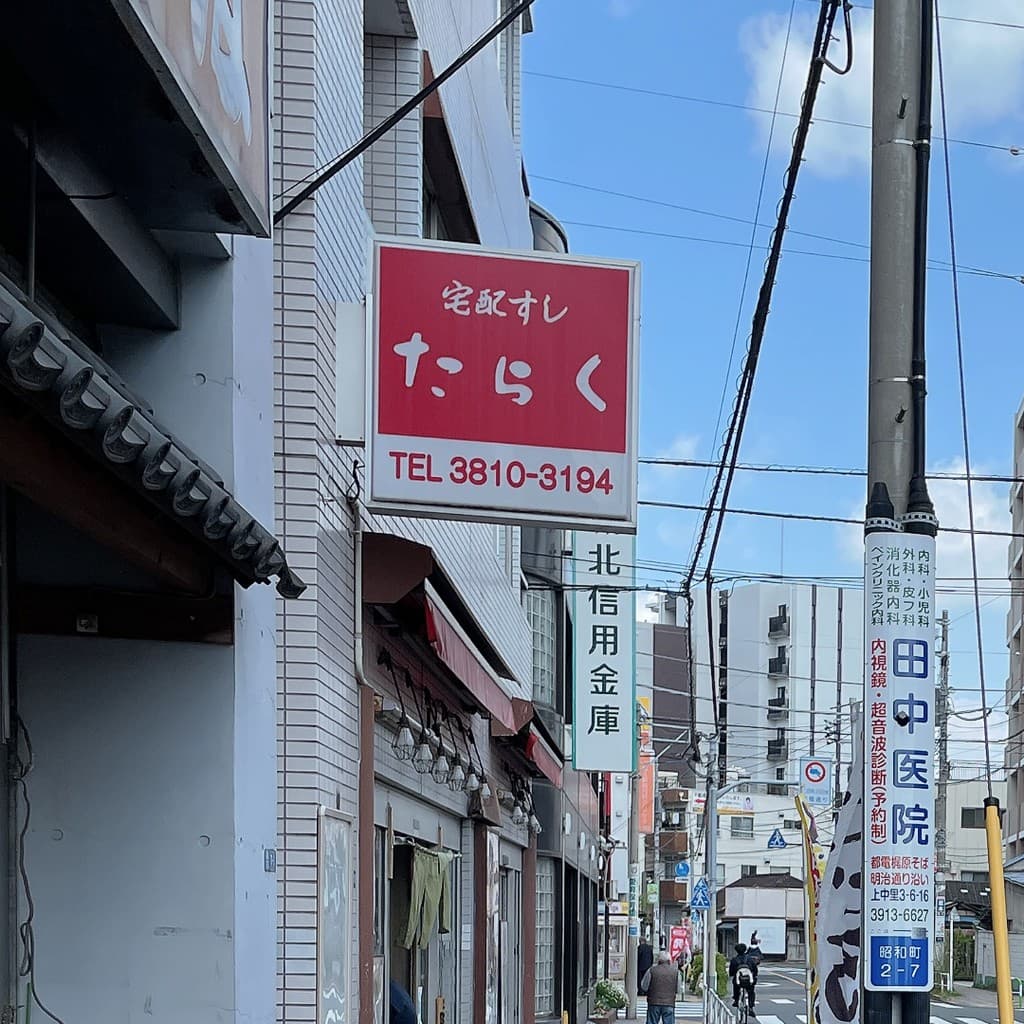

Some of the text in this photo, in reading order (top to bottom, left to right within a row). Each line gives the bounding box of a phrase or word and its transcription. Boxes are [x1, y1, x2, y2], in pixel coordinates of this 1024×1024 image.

[442, 280, 568, 325] 宅配すし
[393, 332, 607, 412] たらく
[389, 451, 613, 495] TEL 3810-3194
[871, 546, 884, 626] ペインクリニック内科
[886, 546, 900, 626] 消化器内科
[902, 547, 915, 627] 外科・皮フ科
[917, 549, 930, 628] 内科・小児科
[587, 543, 620, 736] 北信用金庫
[892, 638, 929, 845] 田中医院
[871, 856, 929, 869] 都電梶原そば
[871, 872, 929, 885] 明治通り沿い
[871, 888, 929, 902] 上中里3-6-16
[871, 908, 929, 922] 3913-6627
[880, 945, 921, 959] 昭和町
